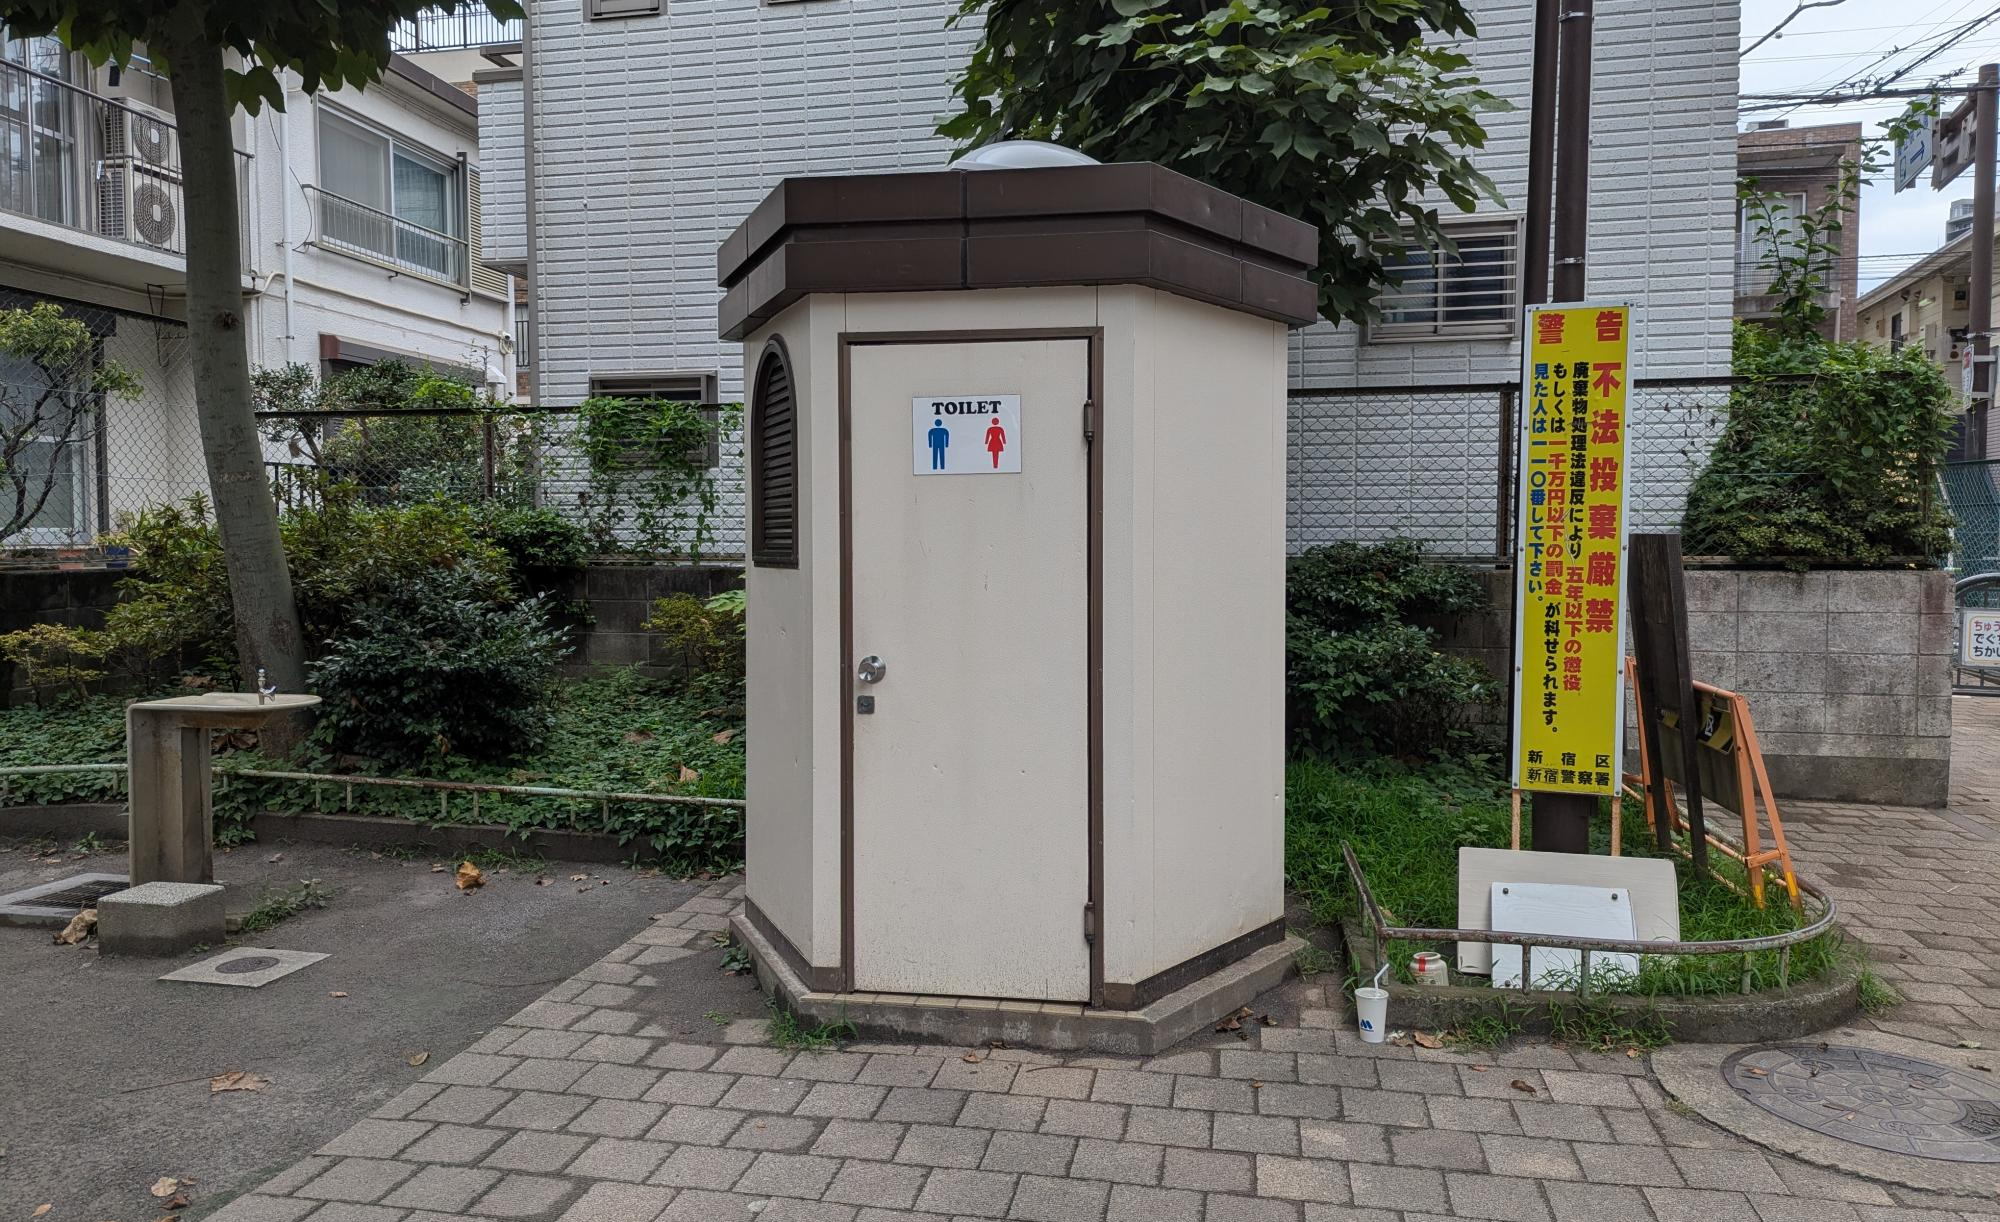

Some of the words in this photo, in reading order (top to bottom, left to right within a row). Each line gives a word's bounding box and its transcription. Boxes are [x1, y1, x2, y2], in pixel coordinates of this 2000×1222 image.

[1538, 310, 1623, 344] 警告
[932, 401, 1001, 415] TOILET
[1586, 362, 1622, 633] 不法投棄厳禁
[1527, 750, 1610, 768] 新宿区
[1527, 767, 1610, 786] 新宿警察署
